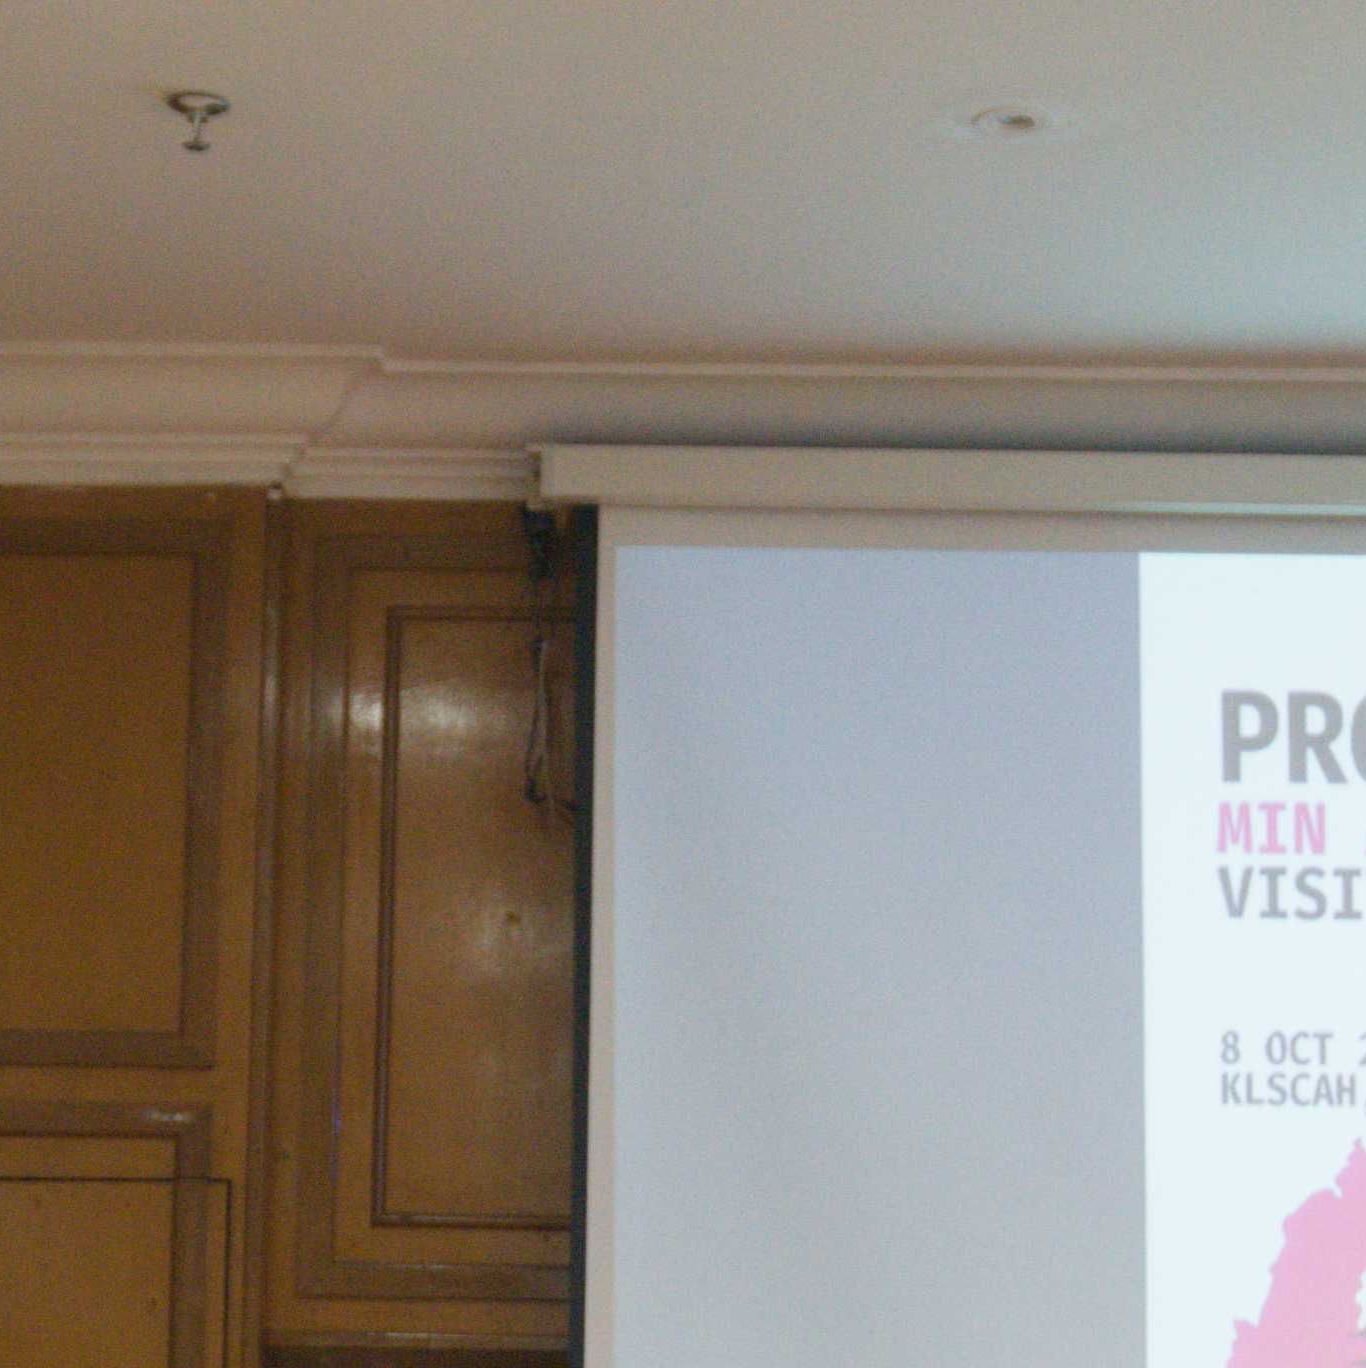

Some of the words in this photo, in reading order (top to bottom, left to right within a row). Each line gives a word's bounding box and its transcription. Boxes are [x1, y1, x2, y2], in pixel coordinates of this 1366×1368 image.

[1218, 802, 1326, 855] MIN
[1221, 1031, 1242, 1065] 8
[1265, 1031, 1334, 1067] OCT
